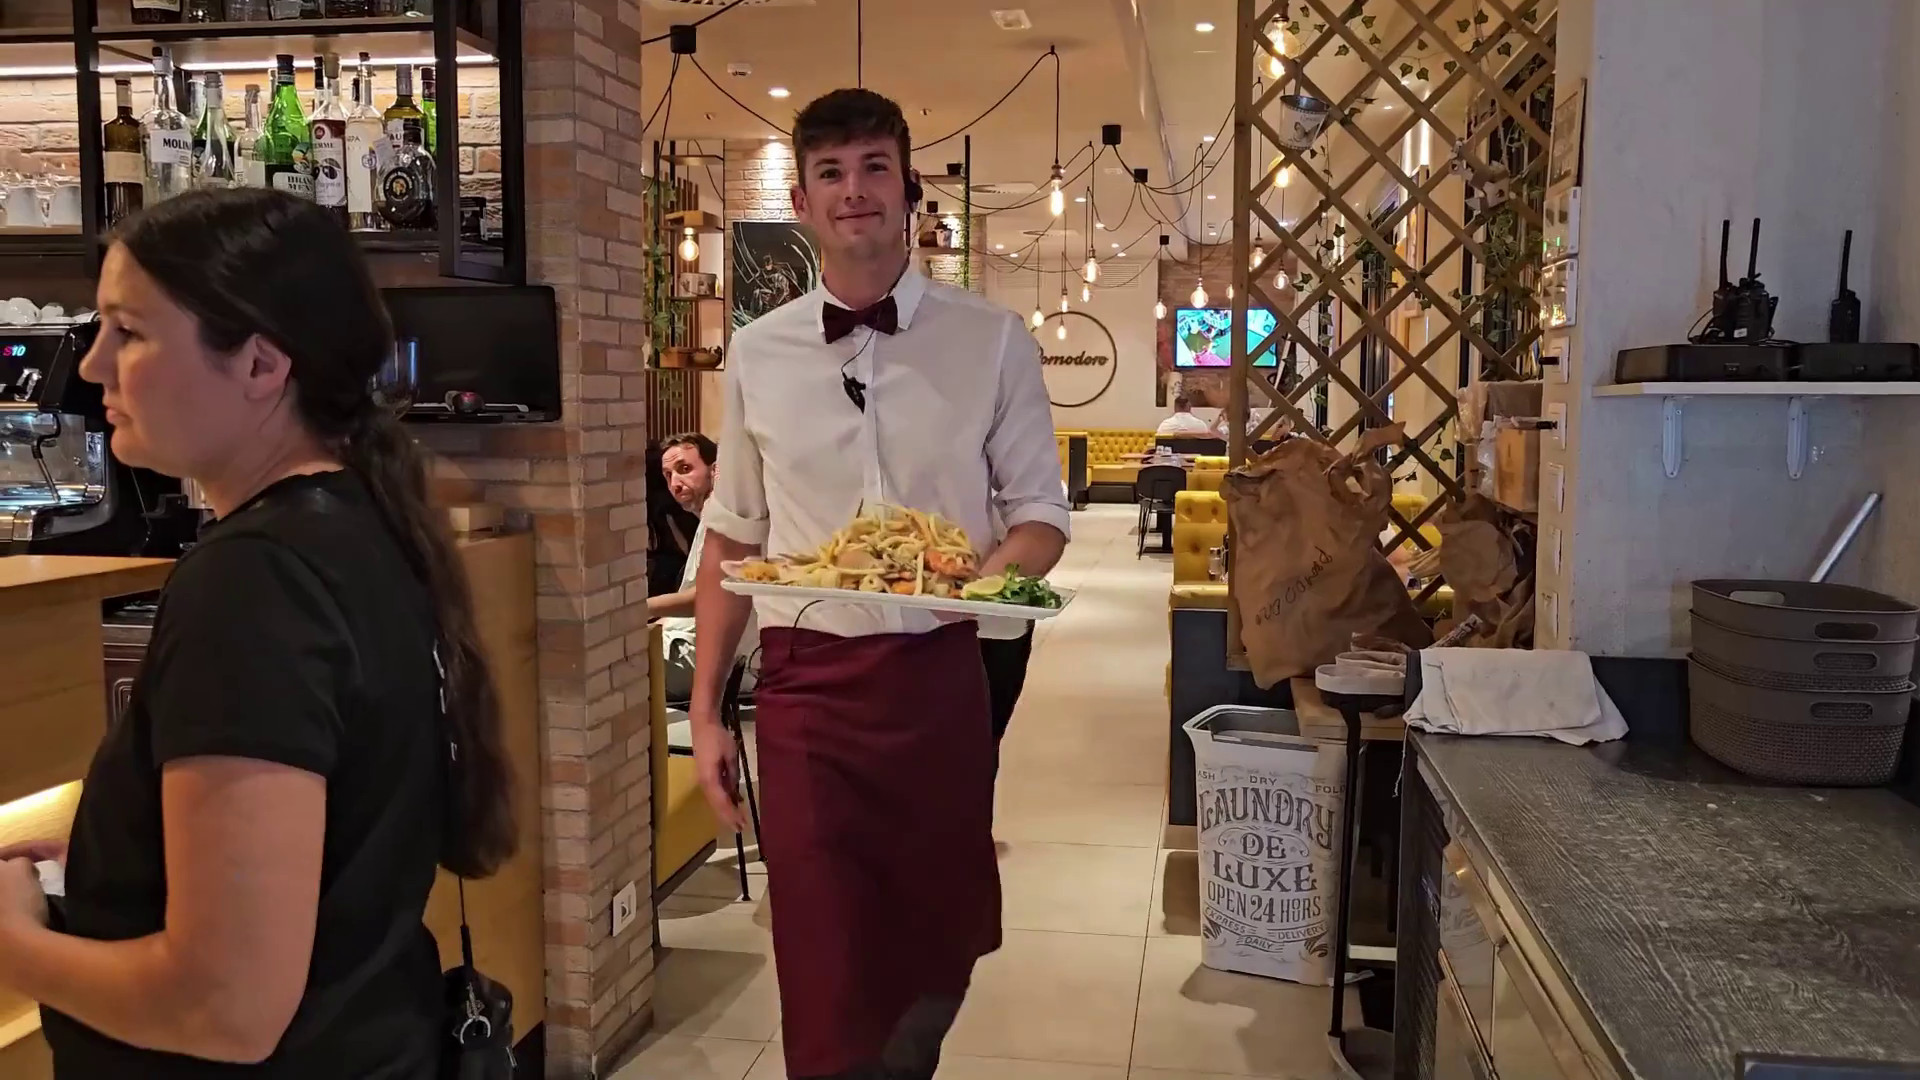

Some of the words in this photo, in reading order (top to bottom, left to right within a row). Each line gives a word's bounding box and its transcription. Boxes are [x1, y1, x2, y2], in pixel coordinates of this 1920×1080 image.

[1249, 775, 1278, 786] DRY
[1199, 786, 1335, 850] LAUNDRY
[1241, 832, 1287, 859] DE
[1213, 850, 1318, 892] LUXE
[1207, 880, 1247, 918] OPEN
[1249, 895, 1276, 923] 24
[1280, 896, 1321, 923] HOURS
[1205, 906, 1246, 935] EXPRESS
[1278, 923, 1326, 940] DELIVERY
[1244, 936, 1274, 949] DAILY
